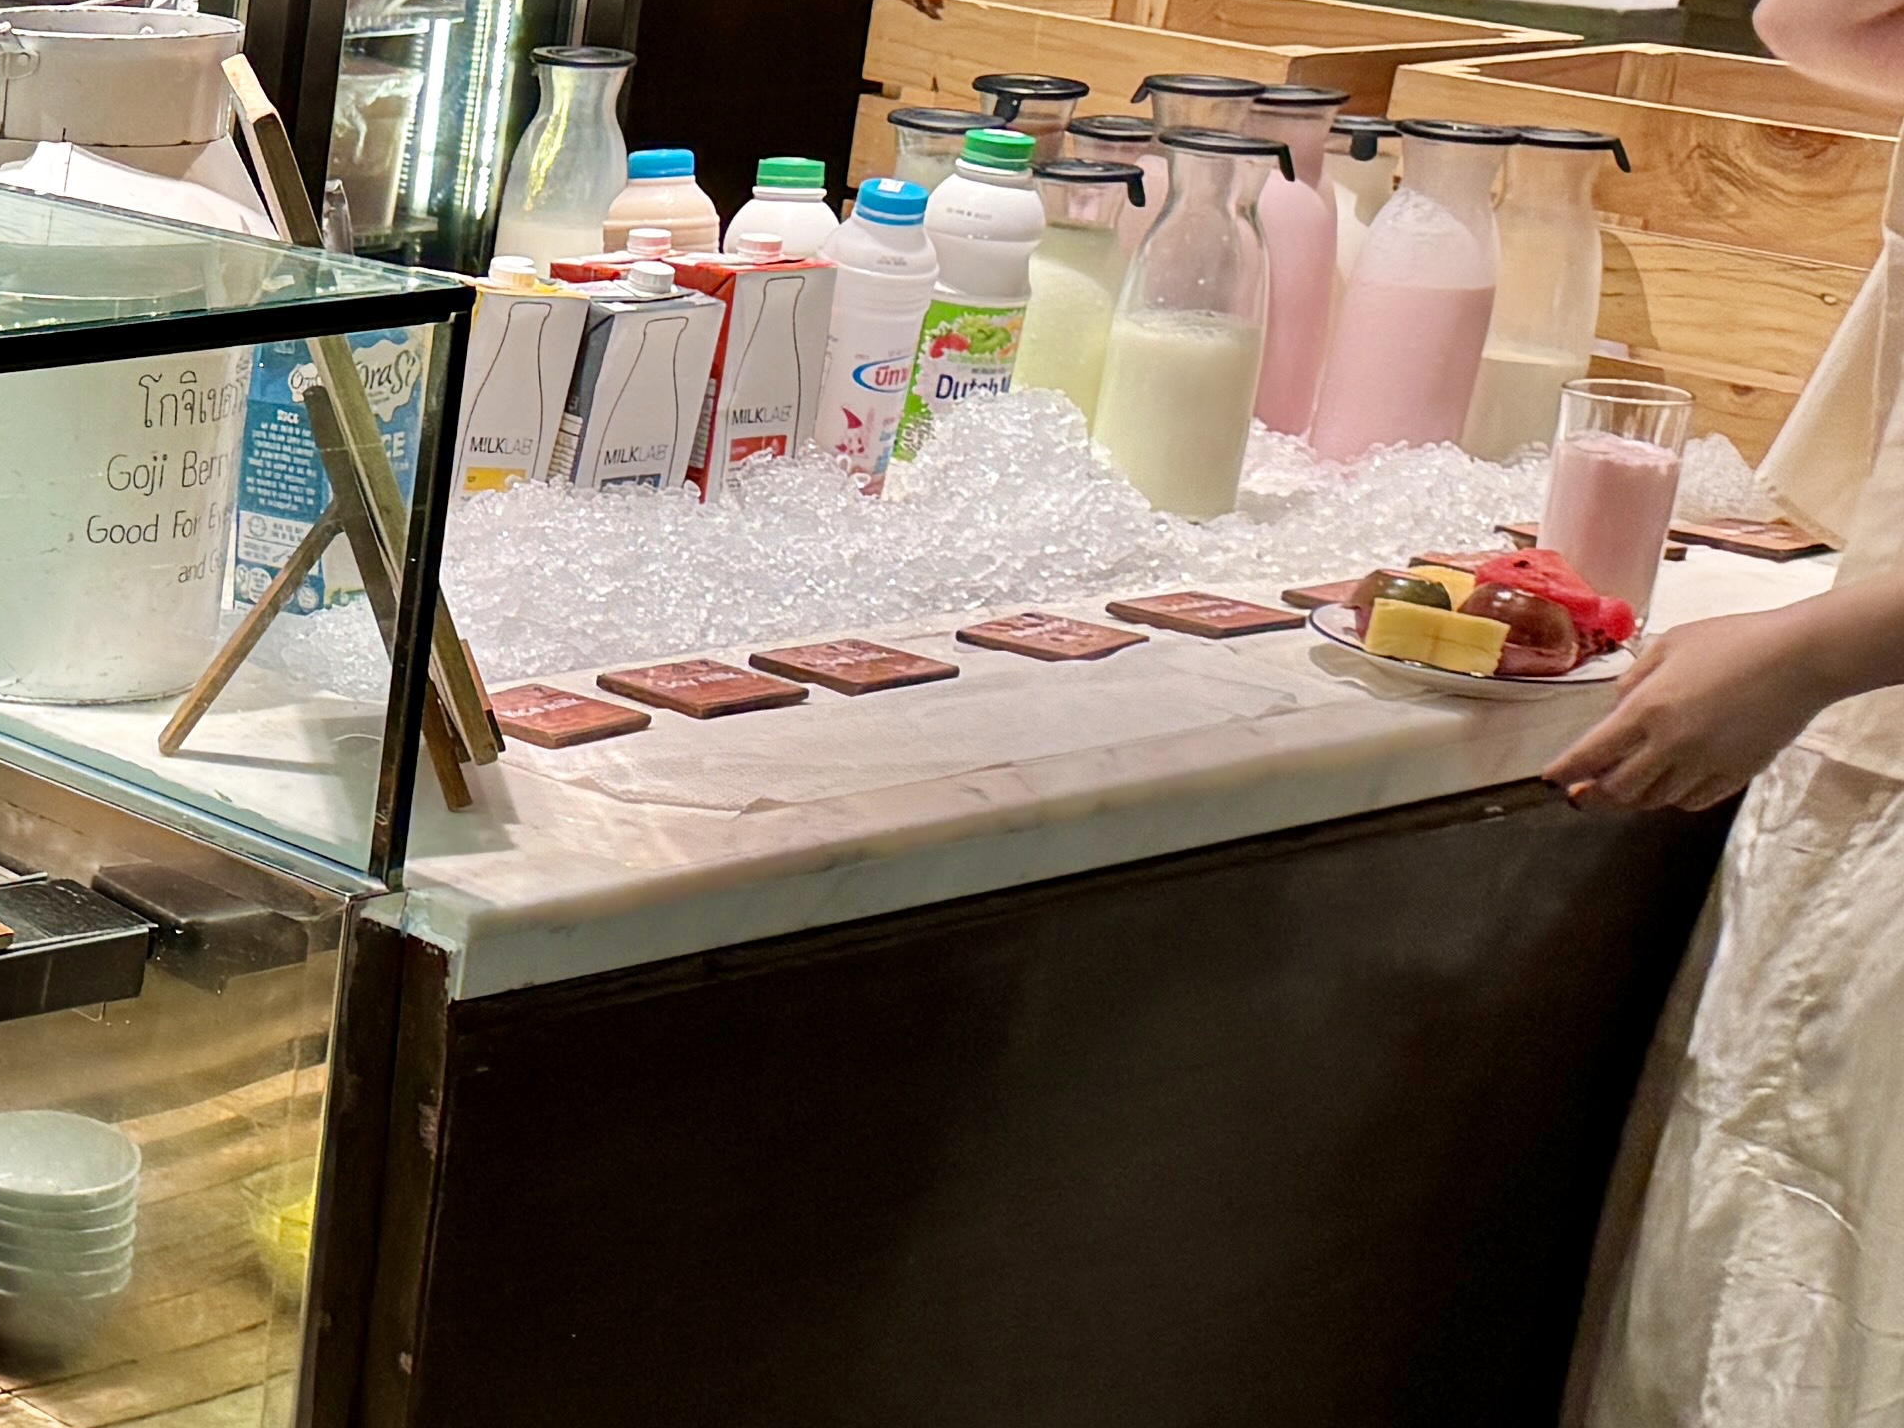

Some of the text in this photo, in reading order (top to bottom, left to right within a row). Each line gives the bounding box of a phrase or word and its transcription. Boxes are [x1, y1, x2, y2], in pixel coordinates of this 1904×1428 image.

[469, 436, 534, 456] MILKLAB
[603, 443, 669, 466] MILKLAB
[106, 452, 169, 497] Goji
[180, 449, 230, 489] Berr
[86, 513, 160, 544] Good
[172, 509, 201, 540] For
[177, 552, 207, 584] and
